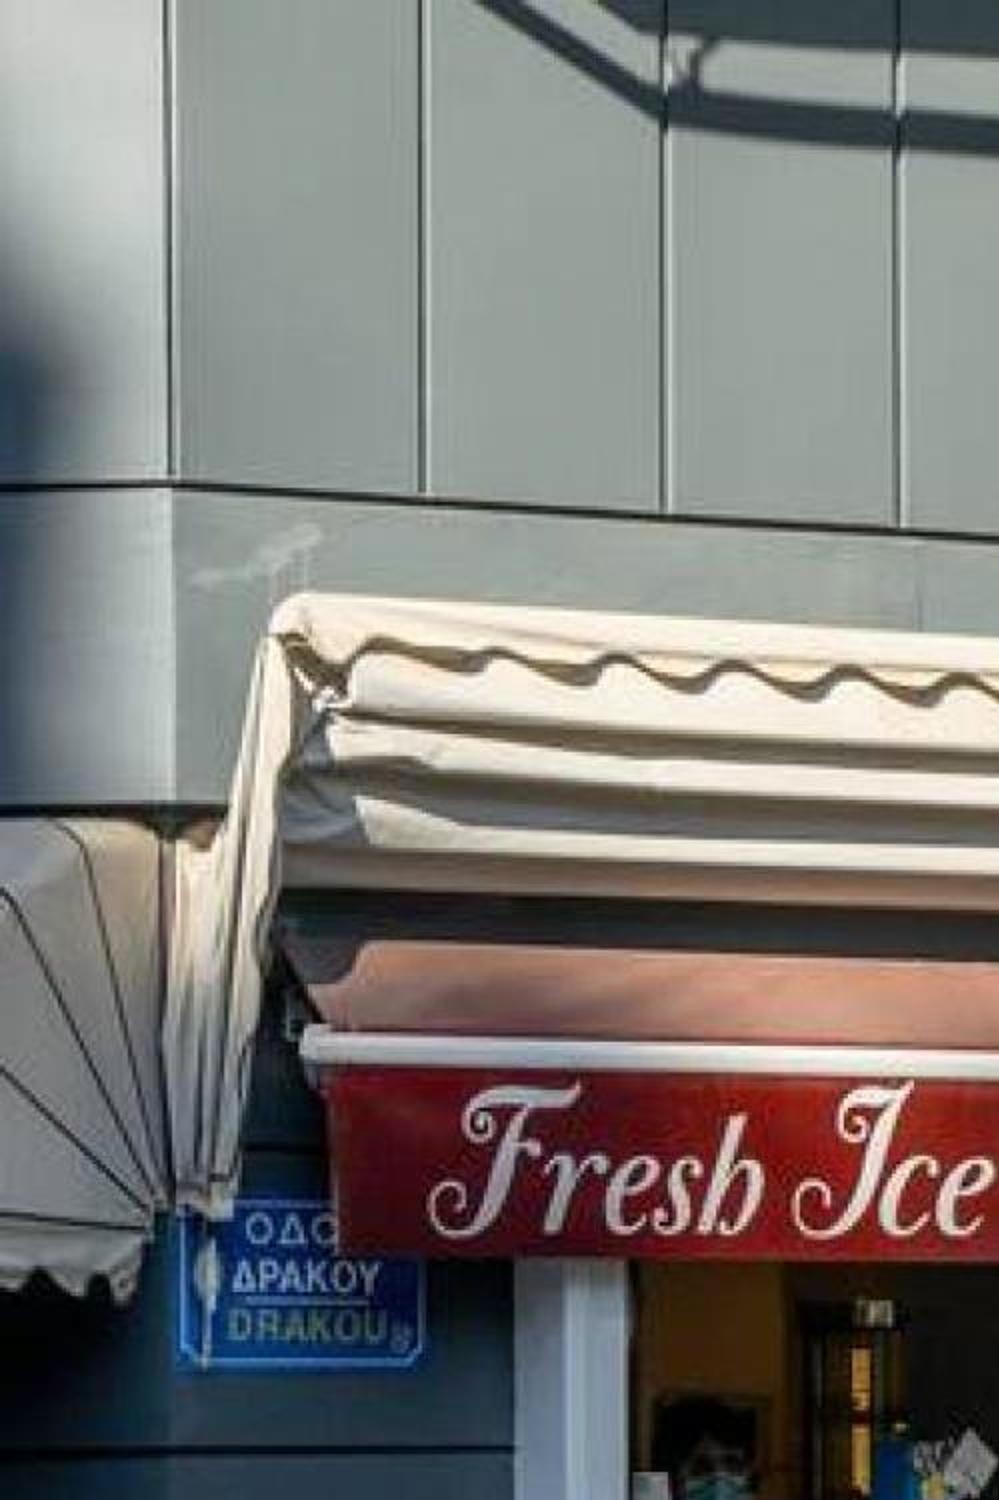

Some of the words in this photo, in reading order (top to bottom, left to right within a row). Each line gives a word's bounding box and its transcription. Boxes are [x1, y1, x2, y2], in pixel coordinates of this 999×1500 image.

[427, 1080, 766, 1239] Fresh
[791, 1079, 997, 1241] Ice
[245, 1211, 339, 1245] ΟΔΟ
[231, 1257, 383, 1296] ΔΡΑΚΟΥ
[226, 1307, 387, 1343] DRAKOU
